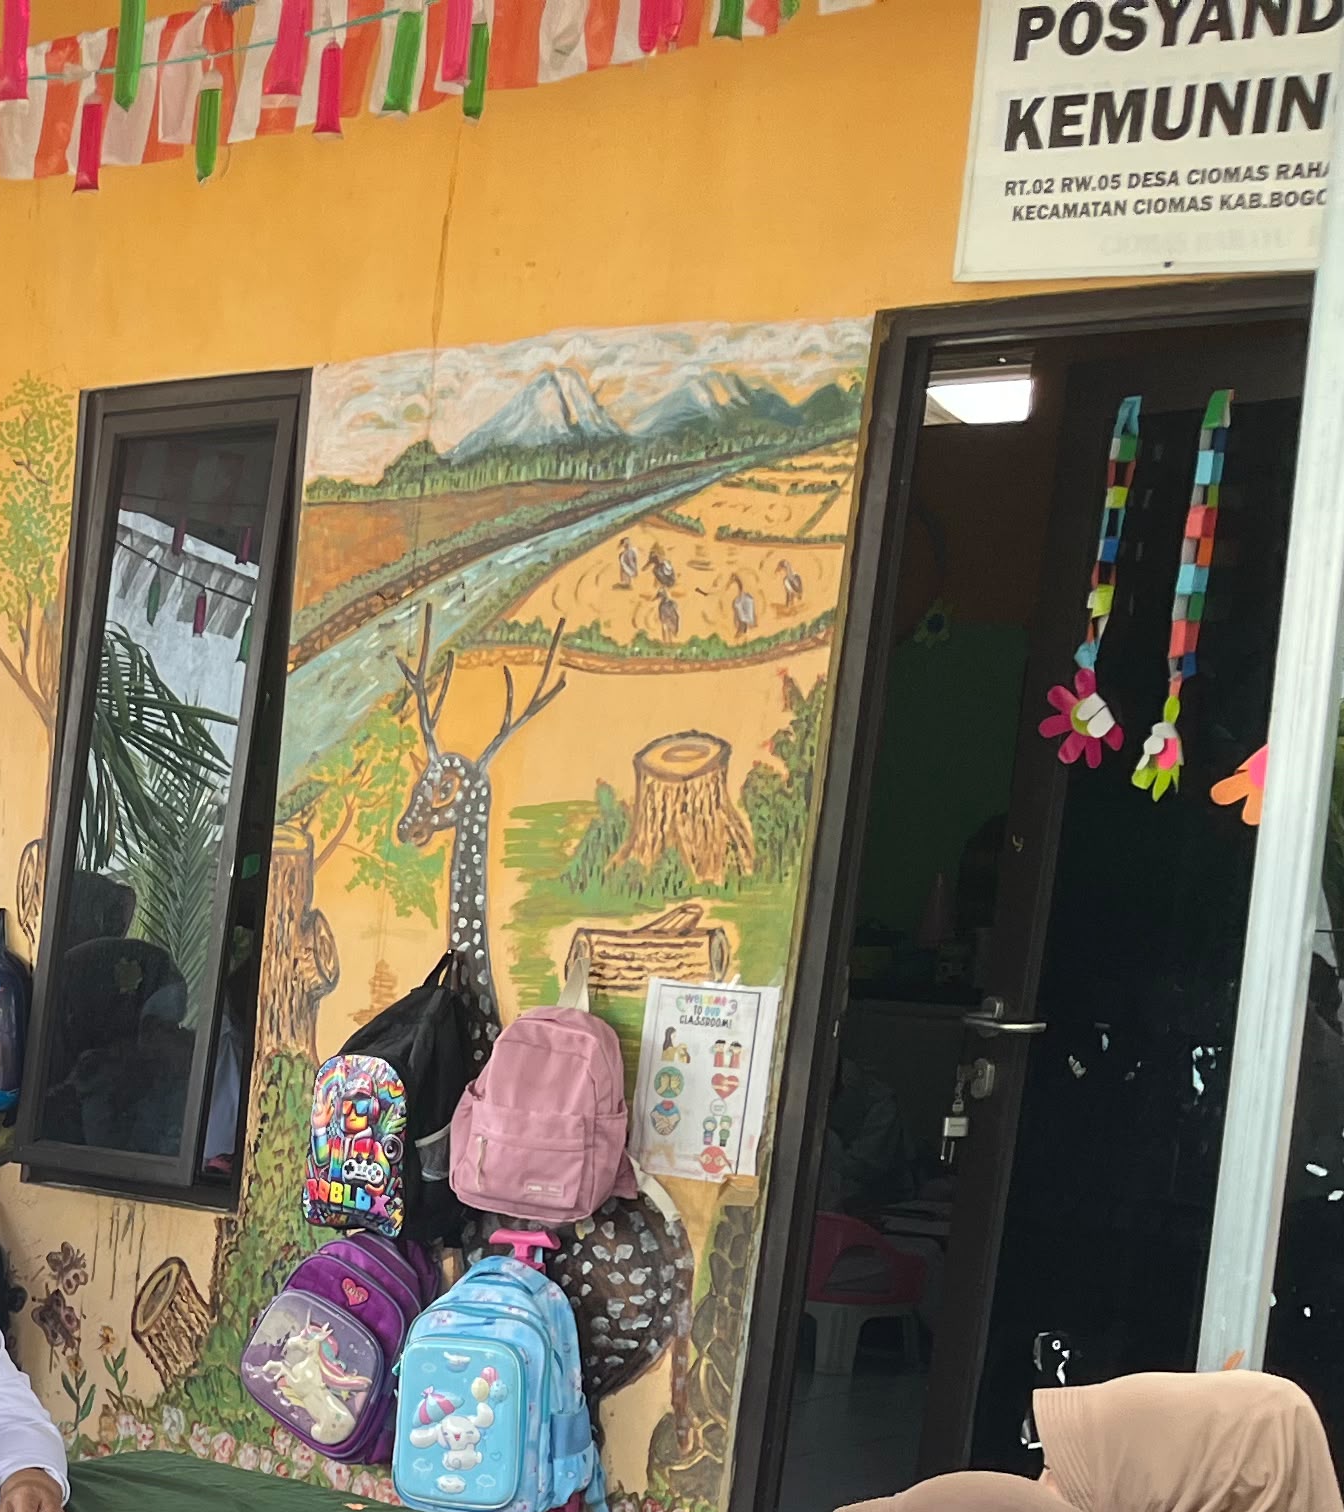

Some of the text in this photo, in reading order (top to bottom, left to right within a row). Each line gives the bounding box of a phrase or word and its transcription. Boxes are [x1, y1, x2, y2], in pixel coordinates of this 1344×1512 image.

[1004, 72, 1333, 152] KEMUNIN
[1004, 178, 1055, 197] RT.02
[1060, 174, 1122, 194] RW.05
[1127, 170, 1180, 189] DESA
[1187, 165, 1270, 186] CIOMAS
[1011, 199, 1128, 222] KECAMATAN
[1132, 195, 1214, 215] CIOMAS
[306, 1178, 391, 1218] ROBLOX
